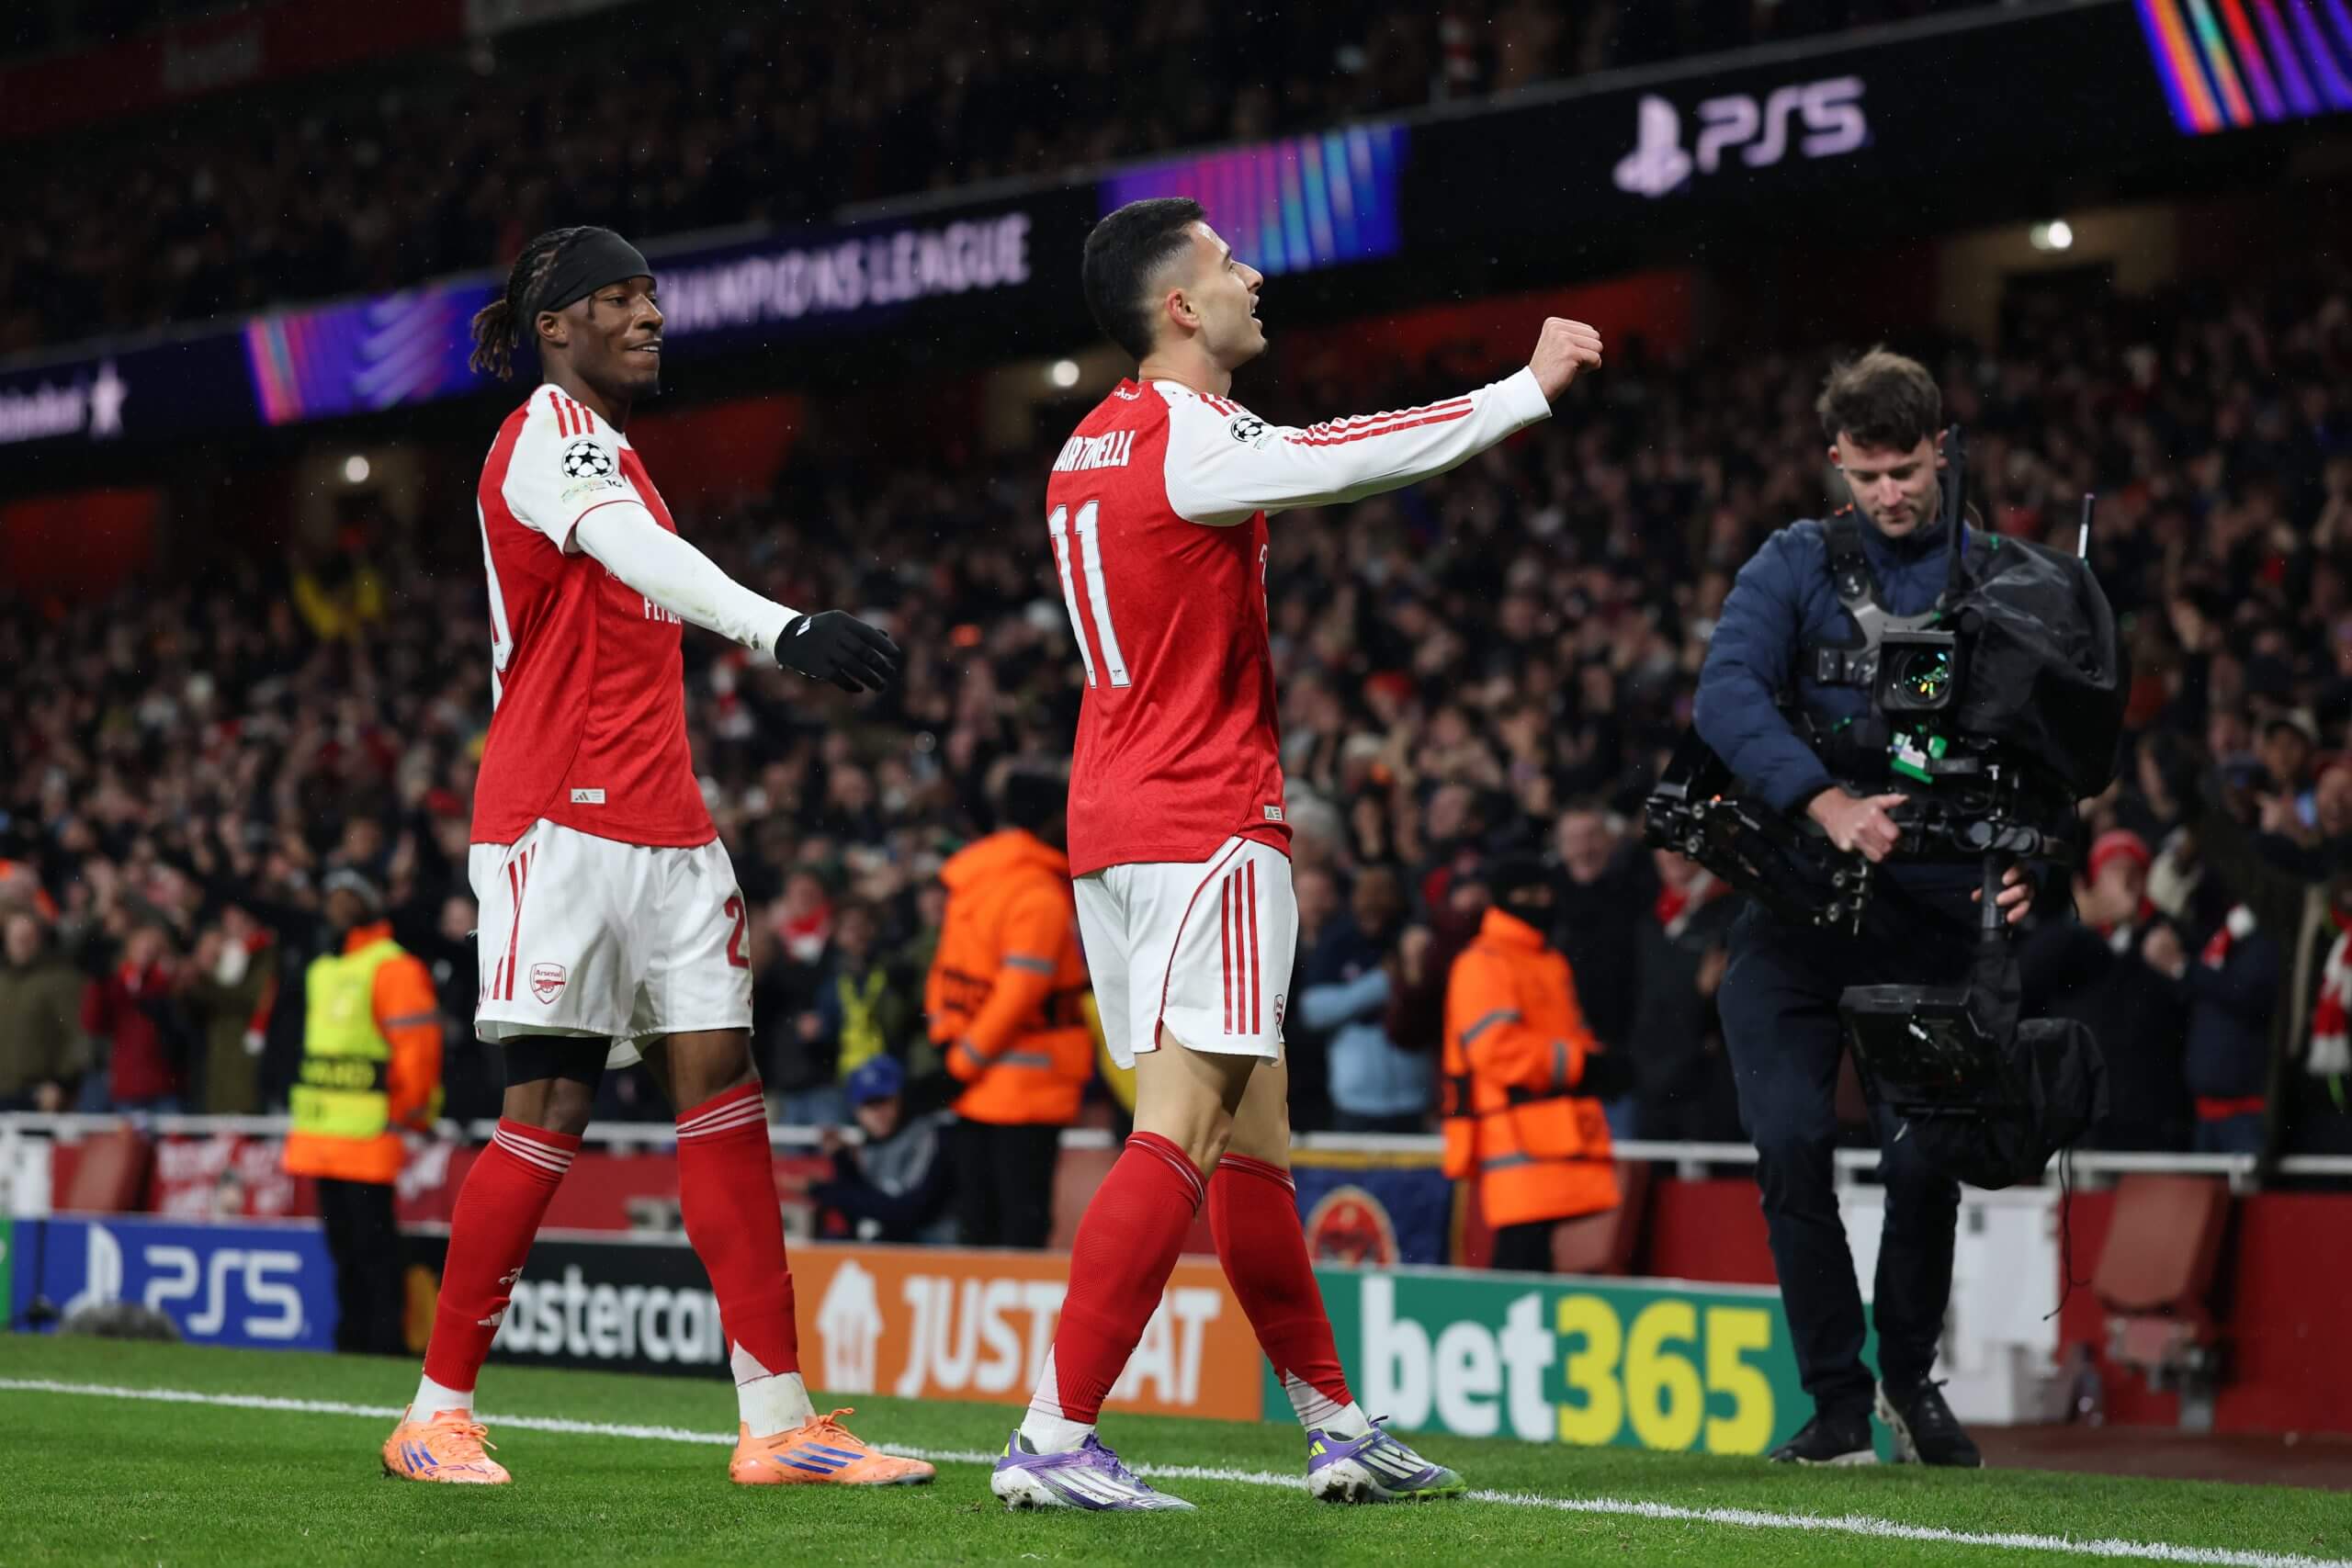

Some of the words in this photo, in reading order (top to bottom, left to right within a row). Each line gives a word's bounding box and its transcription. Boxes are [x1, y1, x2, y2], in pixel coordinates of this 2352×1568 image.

[1696, 77, 1866, 173] PS5
[658, 240, 865, 336] HAMPIONS
[870, 213, 1031, 305] LEAGUE
[1048, 500, 1132, 688] 11
[143, 1246, 303, 1340] PS5
[493, 1264, 723, 1365] astercar
[895, 1274, 1069, 1398] JUST
[1108, 1287, 1222, 1405] AT
[1360, 1276, 1775, 1456] bet365
